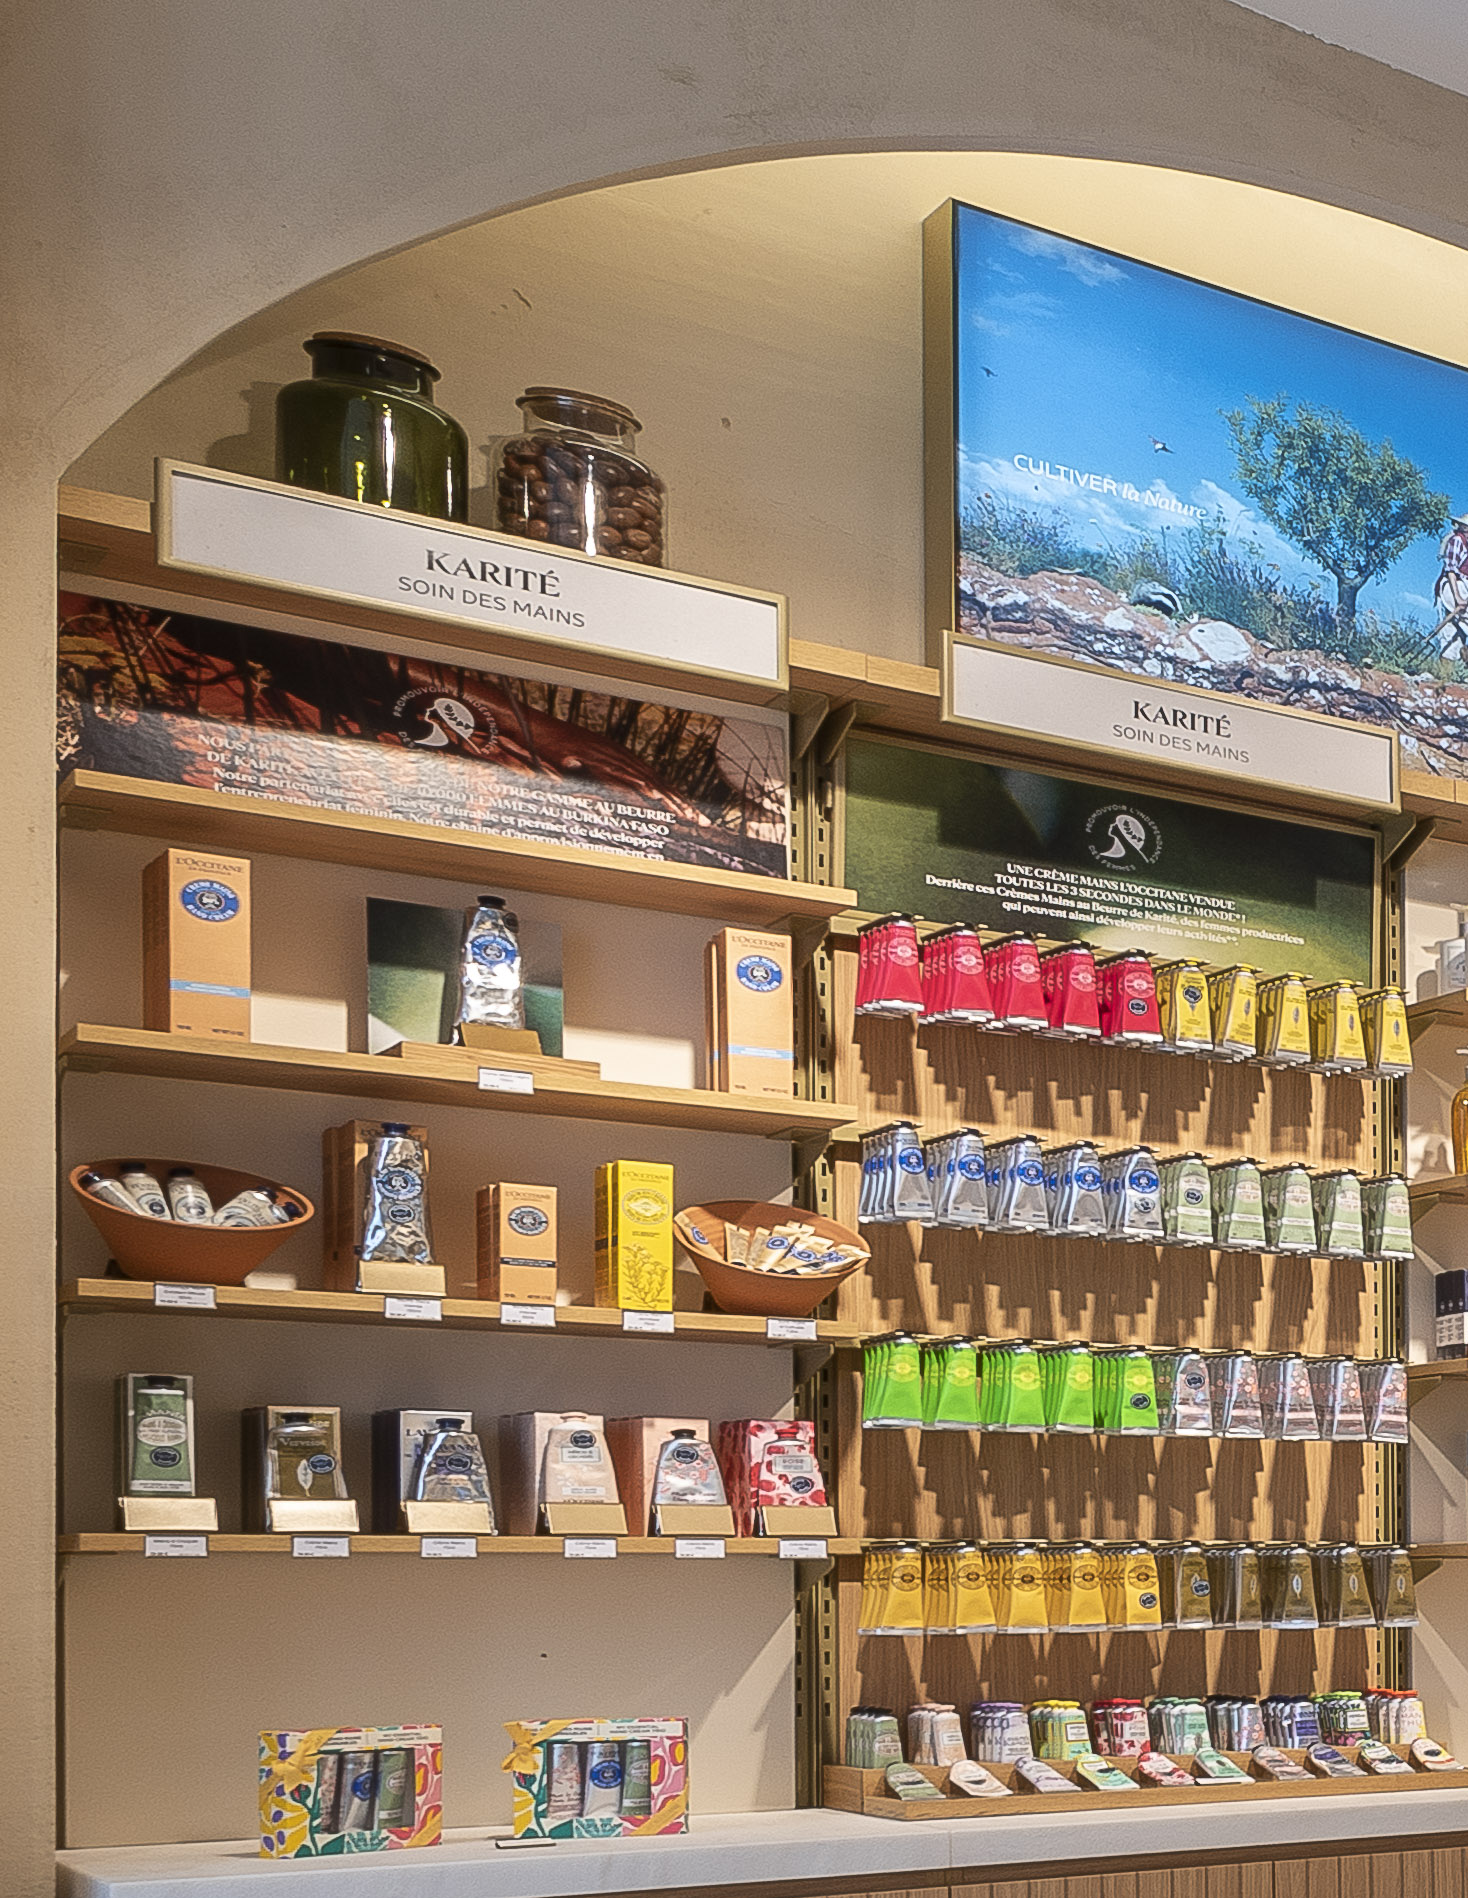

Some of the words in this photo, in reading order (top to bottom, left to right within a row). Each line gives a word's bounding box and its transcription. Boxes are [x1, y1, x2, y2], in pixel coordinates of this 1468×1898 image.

[1013, 454, 1118, 497] CULTIVER
[1121, 484, 1140, 503] la
[1144, 490, 1208, 520] Nature
[426, 549, 561, 598] KARITÉ
[398, 576, 454, 601] SOIN
[462, 589, 506, 612] DES
[513, 600, 585, 628] MAINS
[1133, 700, 1232, 739] KARITÉ
[1113, 724, 1154, 744] SOIN
[1159, 733, 1193, 752] DES
[1196, 741, 1250, 763] MAINS
[617, 804, 676, 824] BEURRE
[994, 873, 1044, 891] TOUTES
[1046, 882, 1069, 895] LES
[1070, 886, 1078, 897] 3
[1078, 888, 1143, 908] SECONDES
[1144, 896, 1176, 912] DANS
[1177, 903, 1192, 915] LE
[1006, 862, 1035, 877] UNE
[1034, 867, 1078, 885] CRÈME
[1080, 874, 1118, 891] MAINS
[1119, 882, 1188, 904] L'OCCITANE
[1189, 893, 1236, 910] VENDUE
[925, 874, 974, 892] Derrière
[976, 884, 996, 895] ces
[996, 887, 1040, 902] Crèmes
[1041, 894, 1075, 908] Mains
[1077, 901, 1091, 910] au
[1092, 901, 1128, 917] Beurre
[1130, 908, 1143, 918] de
[1180, 917, 1199, 928] des
[1200, 919, 1240, 934] femmes
[1242, 927, 1305, 946] productrices
[1002, 900, 1021, 912] qui
[1022, 903, 1067, 918] peuvent
[1068, 910, 1094, 923] ainsi
[1096, 915, 1154, 933] développer
[1156, 925, 1183, 937] leurs
